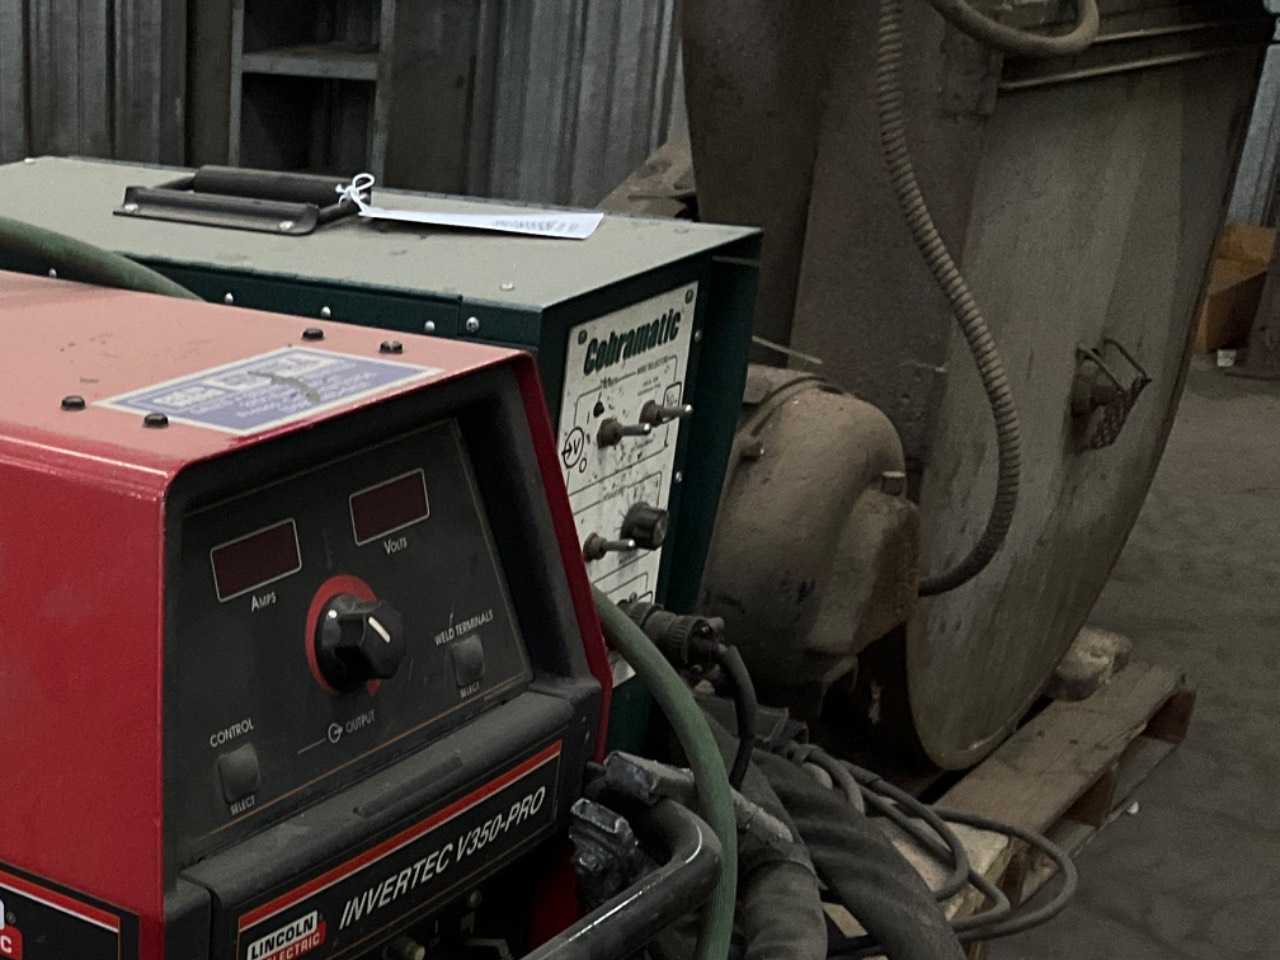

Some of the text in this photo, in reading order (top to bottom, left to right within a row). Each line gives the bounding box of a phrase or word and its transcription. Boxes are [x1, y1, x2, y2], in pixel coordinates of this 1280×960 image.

[583, 307, 681, 376] Cobramatic
[434, 608, 494, 646] WELD TERMINALS
[209, 717, 255, 748] CONTROL
[345, 709, 376, 733] OUTPUT
[229, 795, 256, 815] SELECT
[339, 786, 547, 930] INVERTEC V350-PRO
[250, 915, 314, 960] LINCOLN
